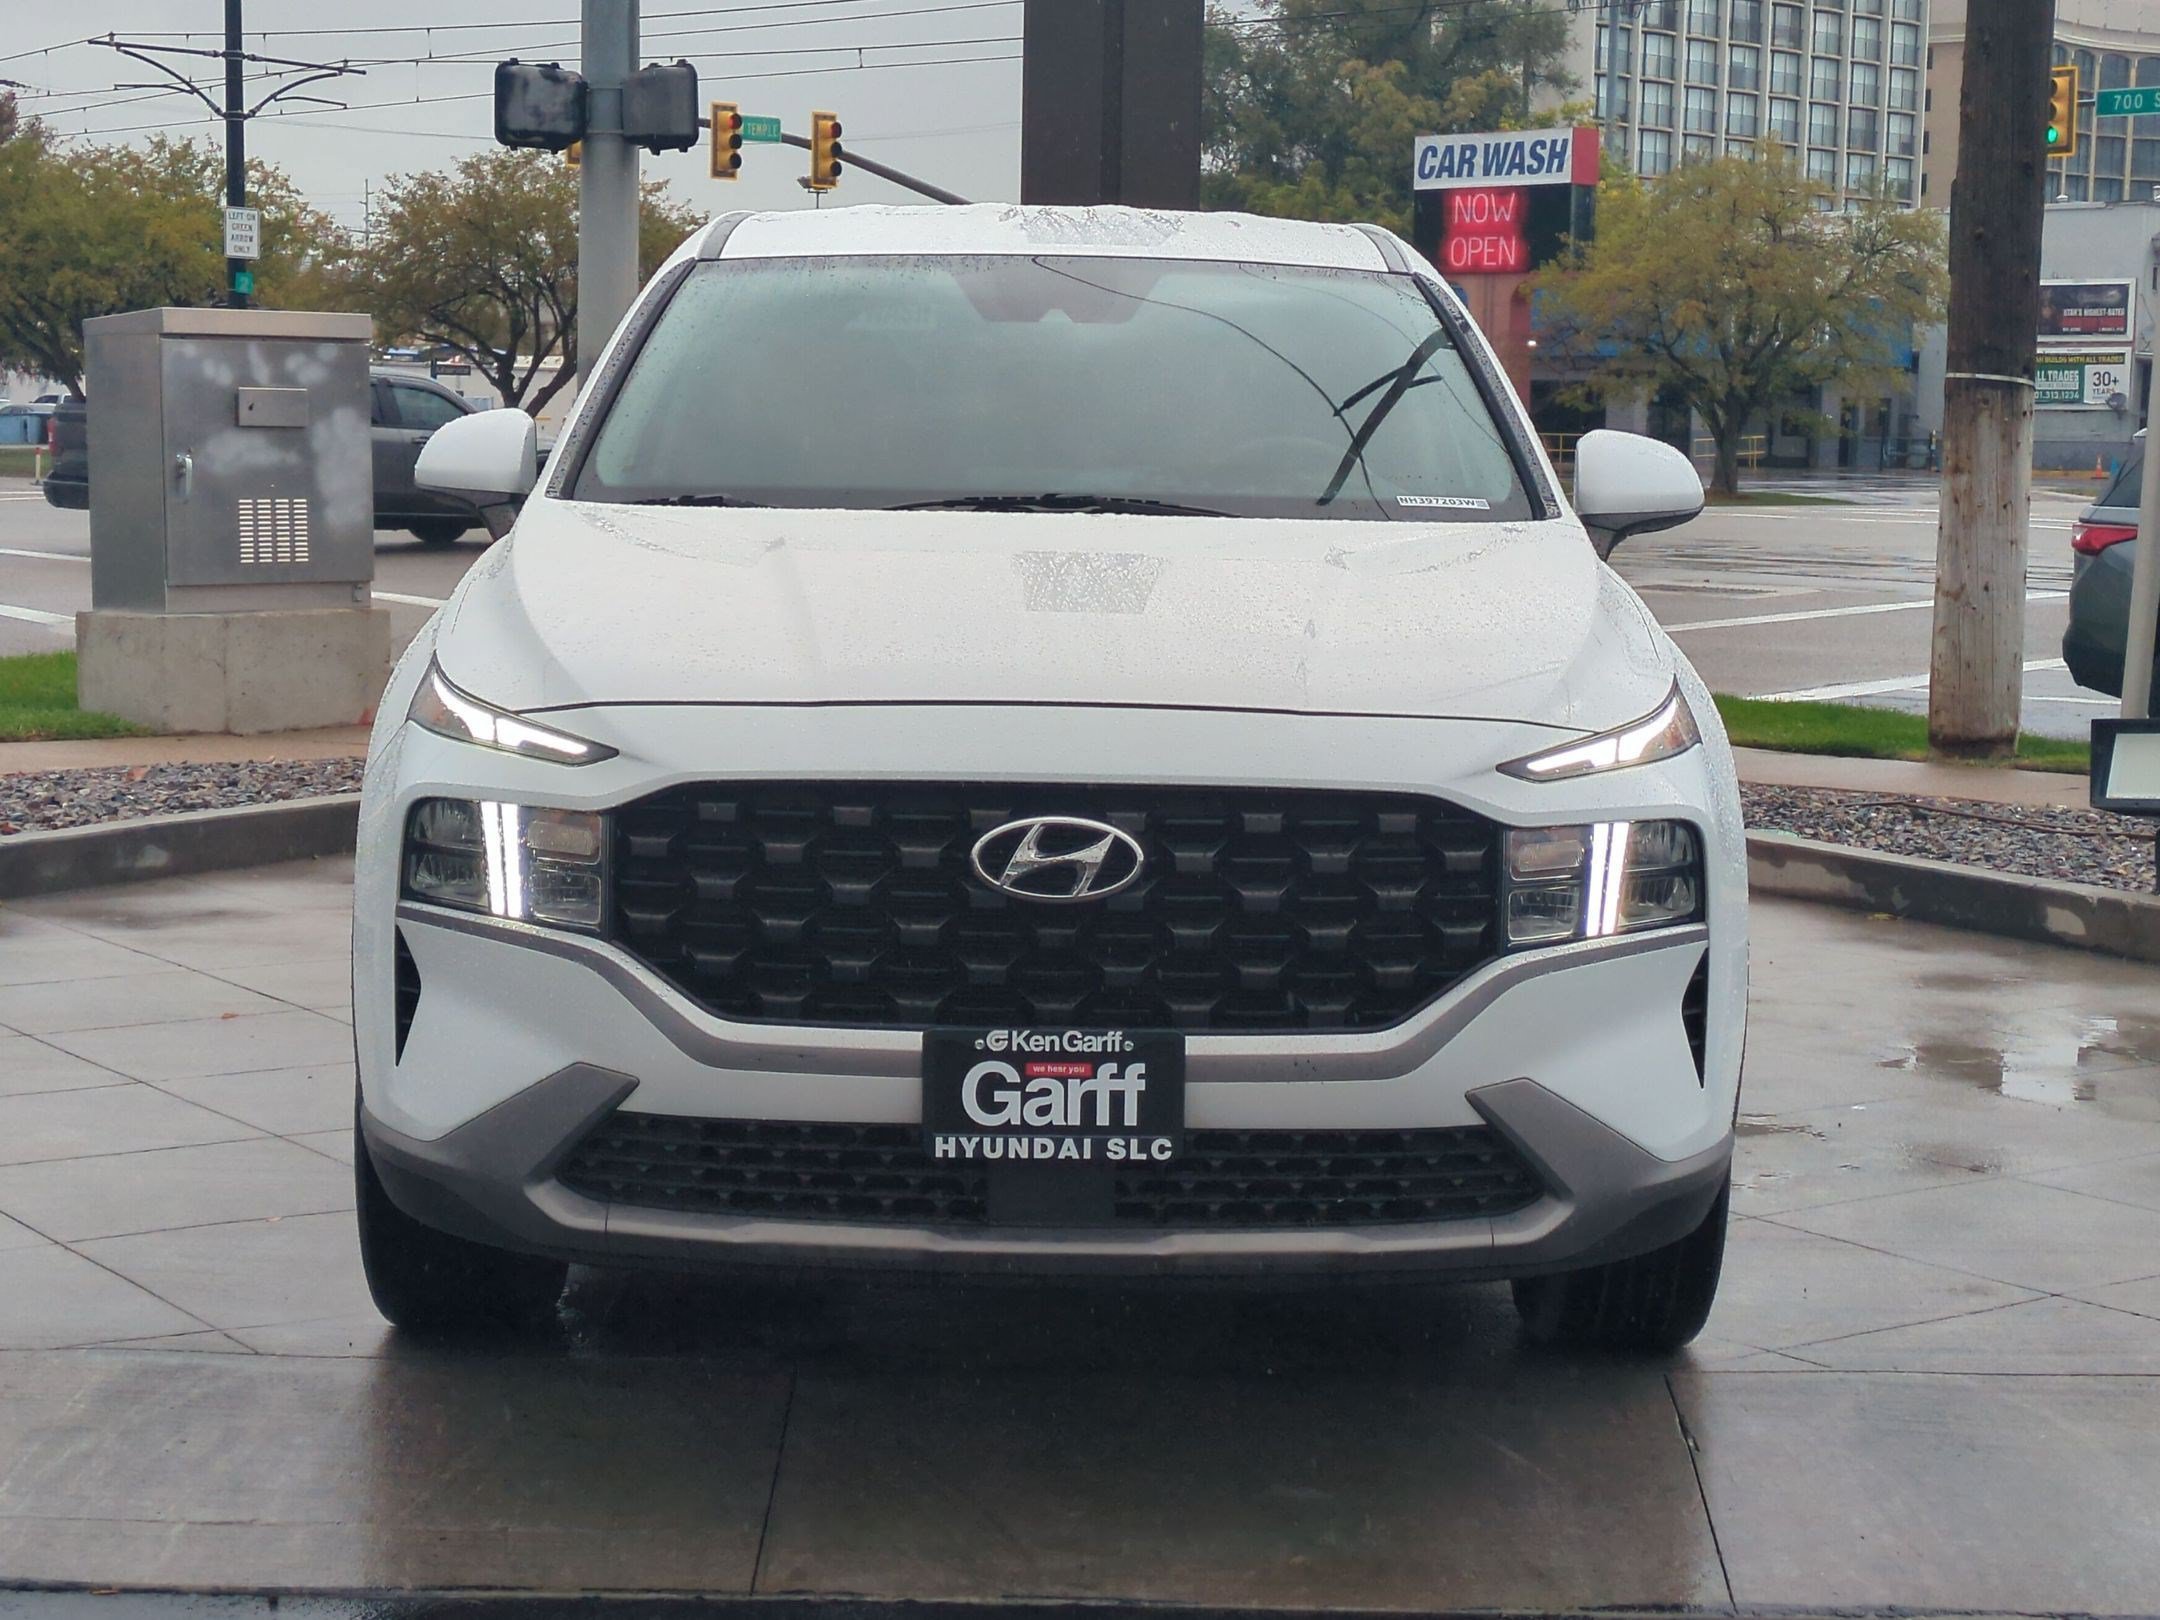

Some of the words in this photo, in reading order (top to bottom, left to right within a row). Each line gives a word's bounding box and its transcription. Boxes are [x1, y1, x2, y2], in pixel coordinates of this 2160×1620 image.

[2114, 94, 2143, 110] 700
[746, 122, 779, 137] TEMPLE
[1417, 144, 1477, 180] CAR
[1482, 138, 1569, 177] WASH
[228, 211, 244, 220] LEFT
[1454, 192, 1516, 224] NOW
[231, 222, 253, 232] GREEN
[231, 233, 254, 243] ARROW
[233, 244, 250, 254] ONLY
[1450, 235, 1516, 267] OPEN
[2048, 369, 2080, 382] TRADES
[2093, 371, 2120, 387] 30+
[1012, 1030, 1062, 1052] Ken
[1062, 1030, 1123, 1053] Garff
[1047, 1064, 1067, 1074] hear
[1068, 1066, 1086, 1076] you
[961, 1060, 1146, 1127] Garff
[934, 1136, 1092, 1160] HYUNDAI
[1105, 1138, 1173, 1161] SLC
